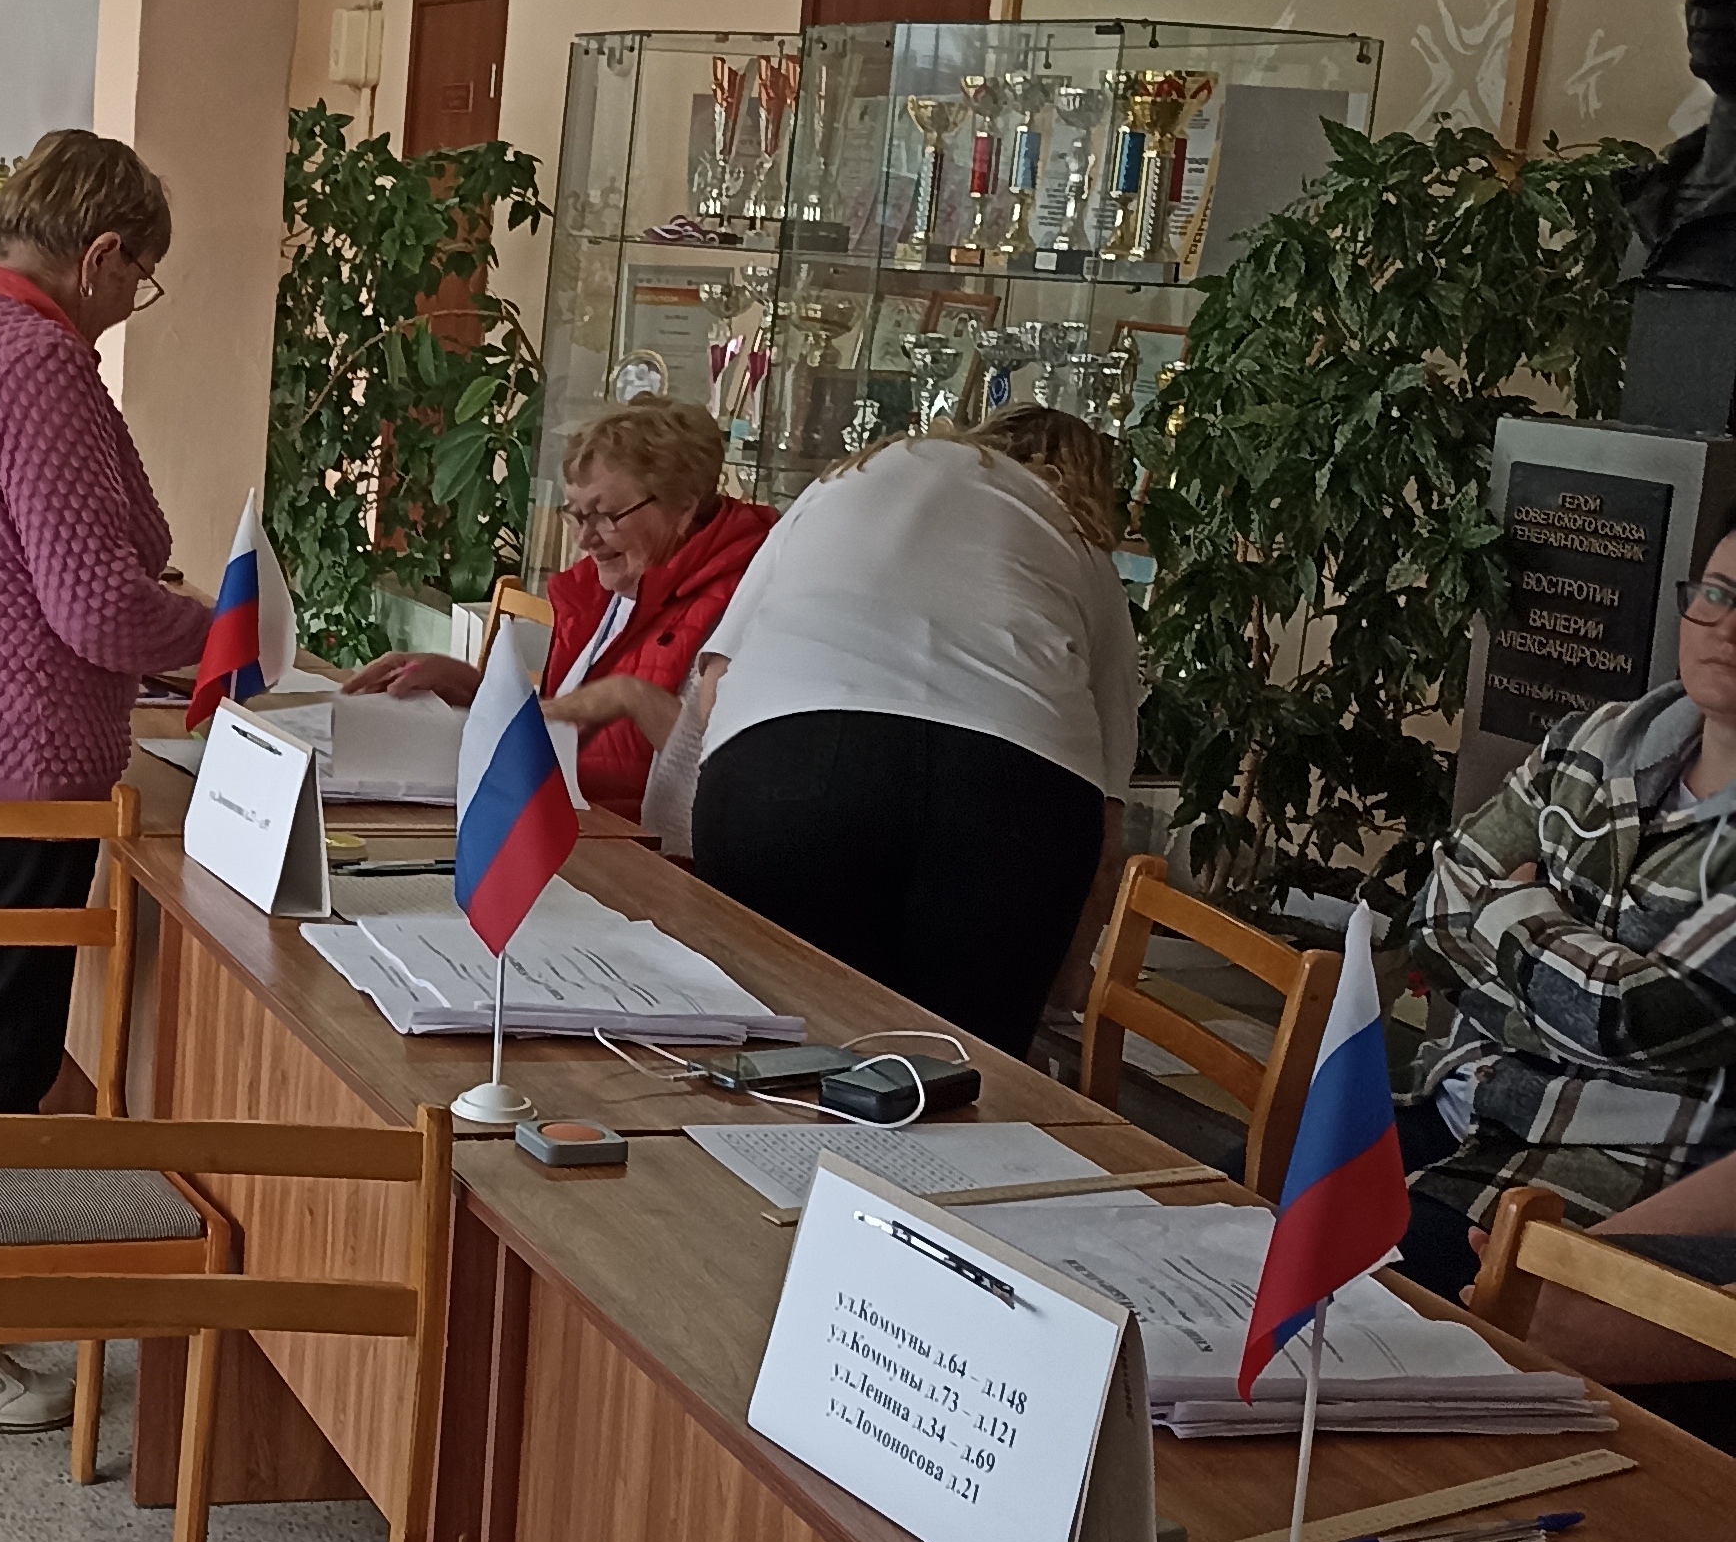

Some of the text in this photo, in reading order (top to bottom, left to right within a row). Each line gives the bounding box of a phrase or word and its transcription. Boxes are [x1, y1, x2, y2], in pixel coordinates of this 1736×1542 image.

[1515, 506, 1596, 533] СОВЕТСКОГО
[1523, 571, 1619, 607] ВОСТРОТИН
[1496, 630, 1632, 674] АЛЕКСАНДРОВИЧ
[827, 1324, 923, 1392] ул.Коммуны
[924, 1384, 959, 1413] д.73
[973, 1413, 1017, 1448] д.121
[835, 1291, 932, 1358] ул.Коммуны
[933, 1350, 968, 1378] д.64
[981, 1378, 1028, 1415] д.148
[826, 1398, 980, 1505] ул.Ломоносова д.21
[830, 1363, 910, 1422] ул.Ленина
[912, 1414, 946, 1443] д.34
[960, 1445, 996, 1473] д.69
